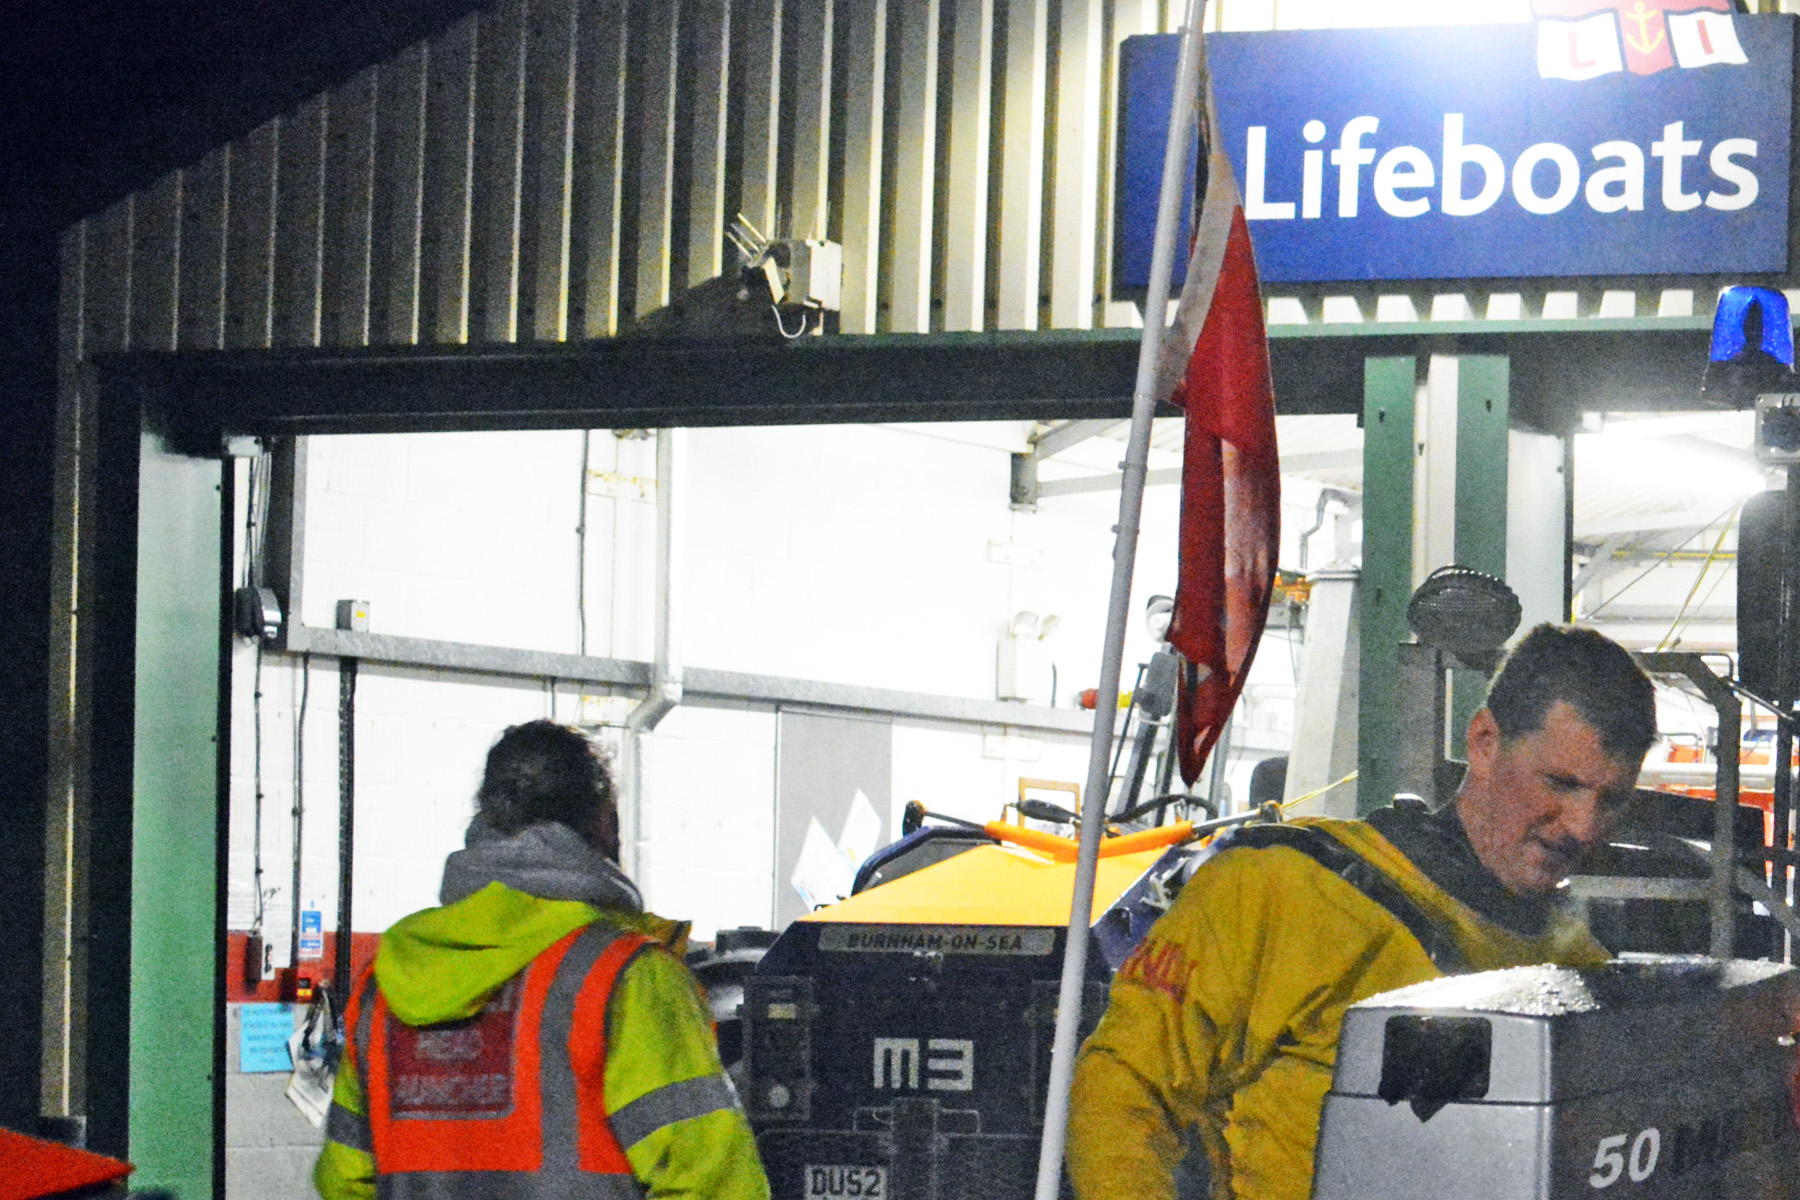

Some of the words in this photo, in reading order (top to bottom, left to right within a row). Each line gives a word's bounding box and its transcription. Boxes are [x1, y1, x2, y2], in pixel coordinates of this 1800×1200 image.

[1245, 113, 1759, 220] Lifeboats
[847, 932, 1023, 951] BURNHAM-ON-SEA
[1589, 1128, 1661, 1189] 50
